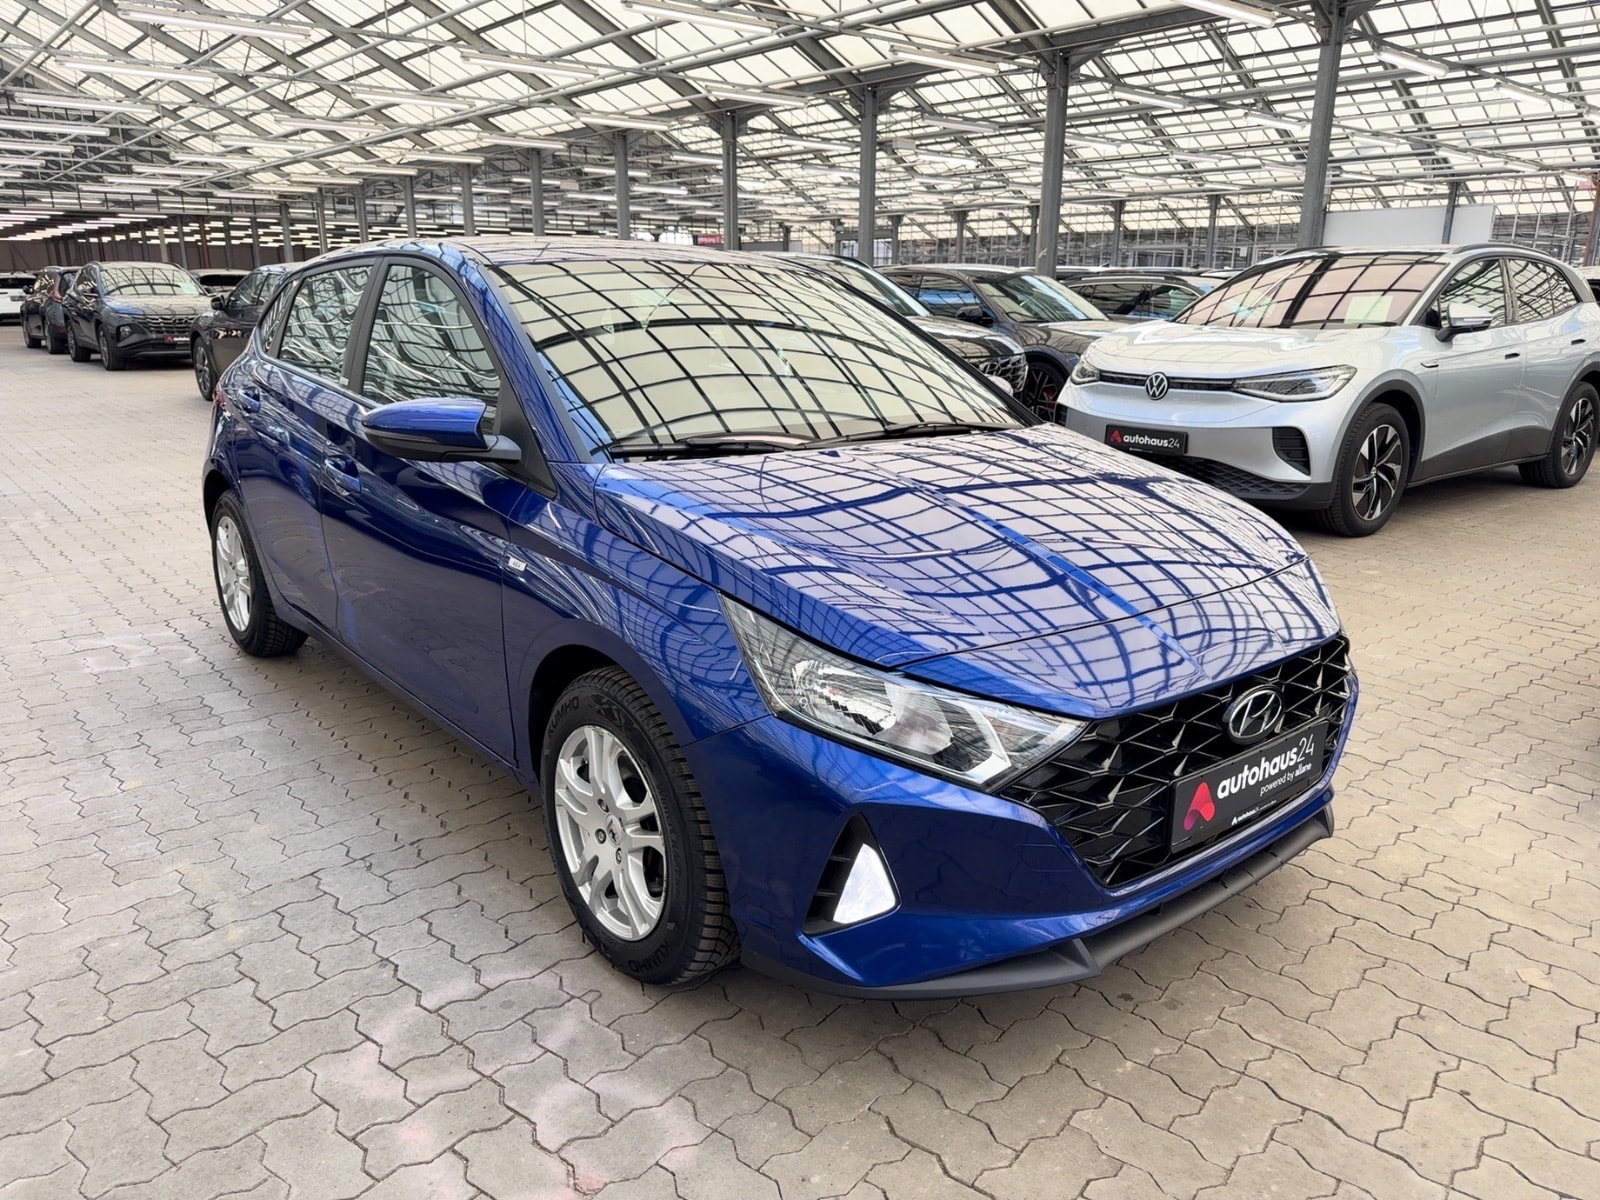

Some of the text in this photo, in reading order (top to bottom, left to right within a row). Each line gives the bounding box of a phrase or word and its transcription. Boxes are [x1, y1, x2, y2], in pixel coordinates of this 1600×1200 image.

[1123, 434, 1180, 449] autohaus24
[547, 695, 580, 739] KUMHO
[1217, 733, 1315, 799] autohaus24
[1260, 772, 1287, 797] powered
[1287, 771, 1295, 782] by
[628, 939, 673, 973] KUMHO
